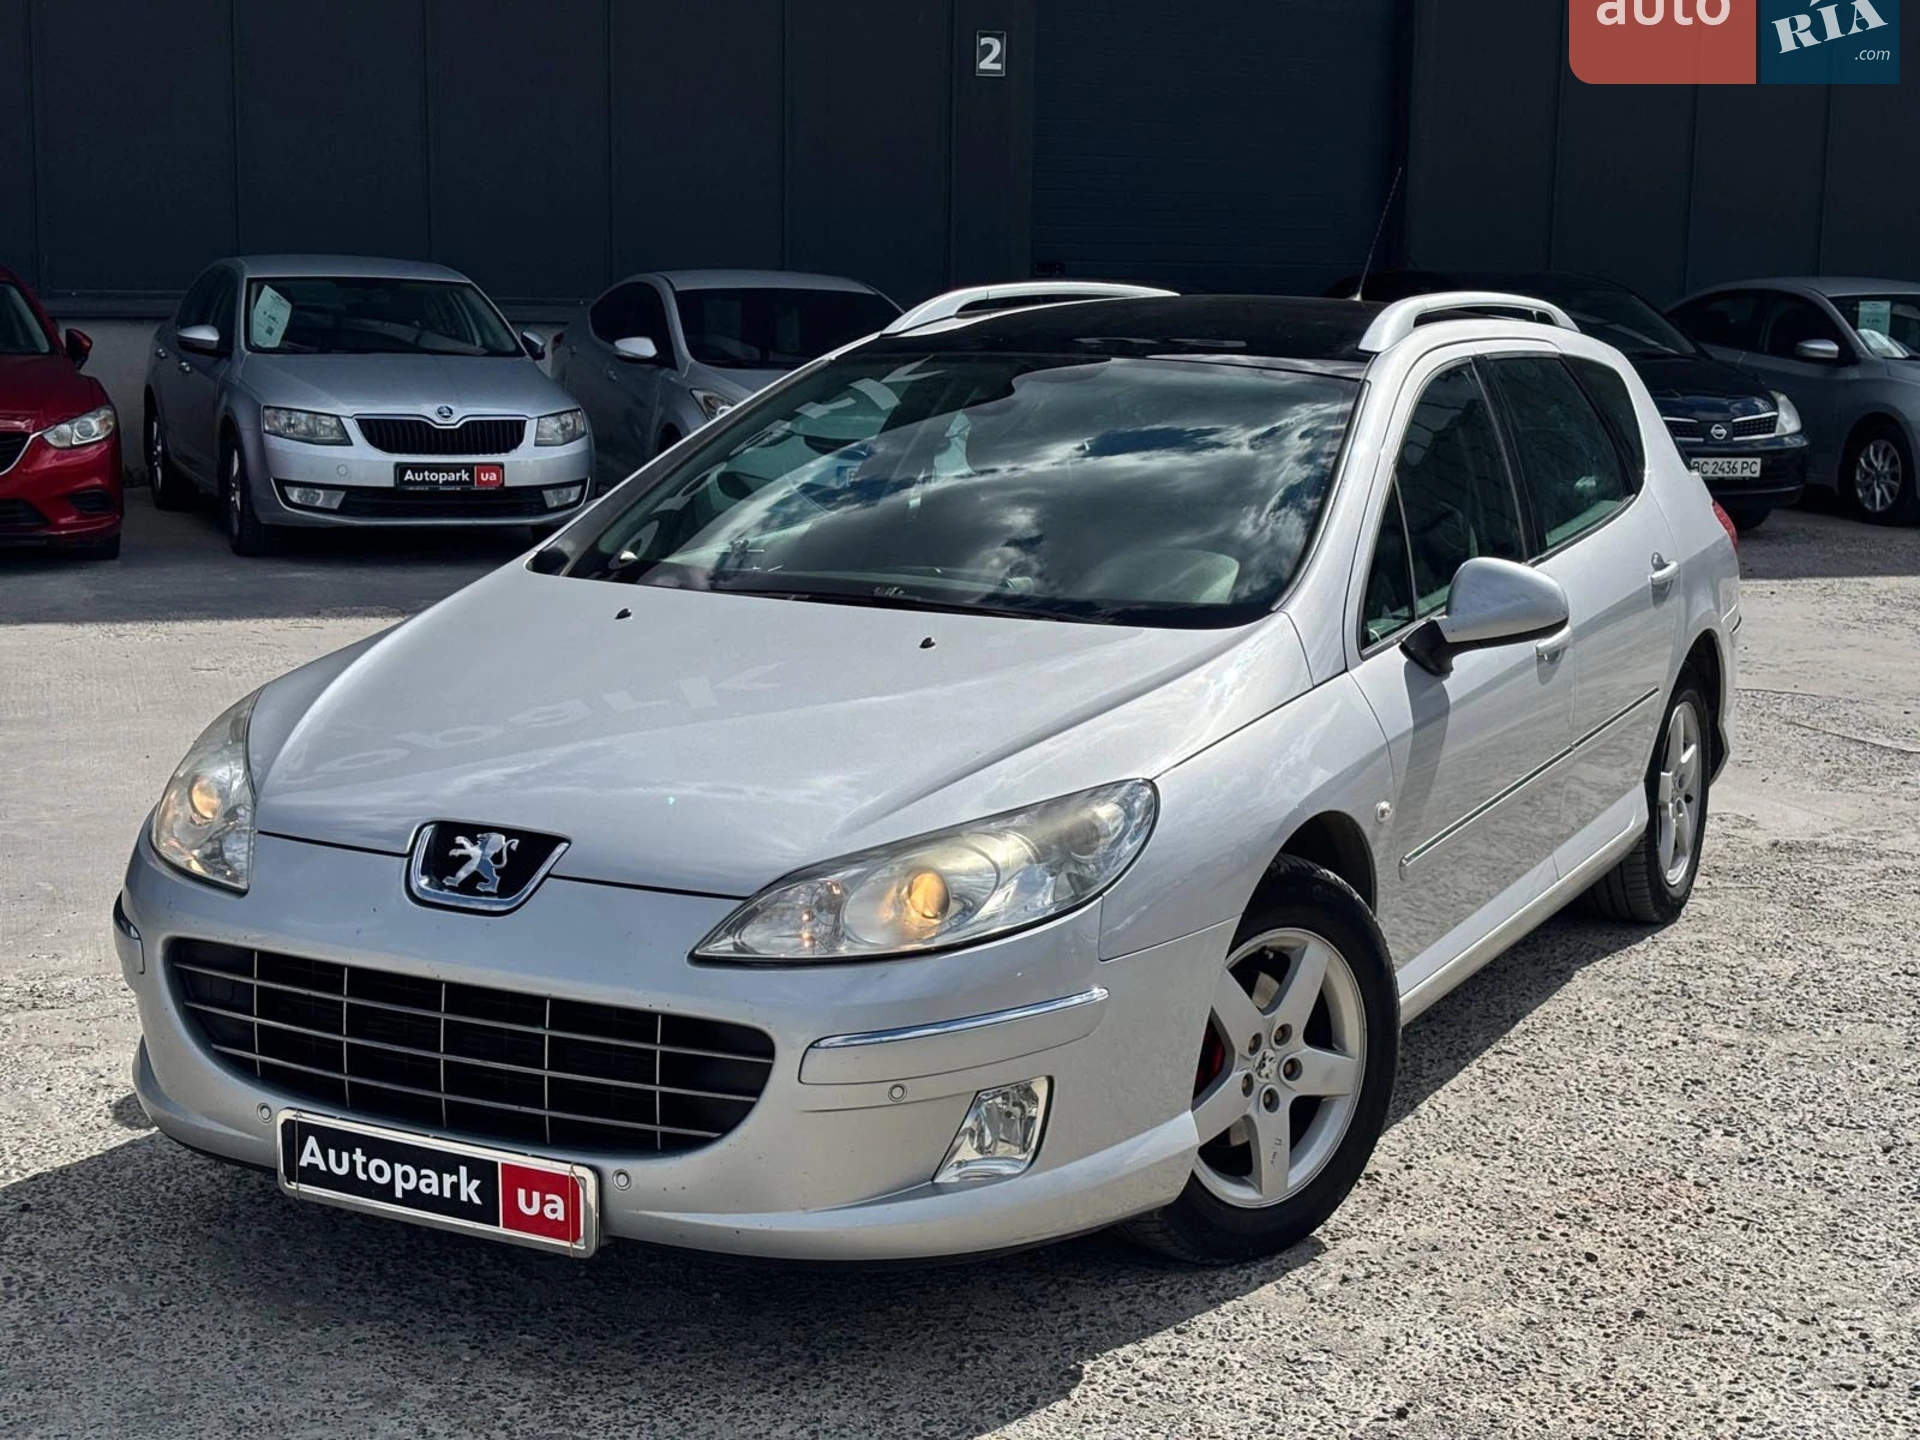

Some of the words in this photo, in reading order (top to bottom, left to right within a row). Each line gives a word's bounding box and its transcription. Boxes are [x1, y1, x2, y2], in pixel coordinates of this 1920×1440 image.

[979, 37, 1002, 70] 2
[403, 469, 470, 484] Autopark
[481, 472, 497, 481] ua
[1711, 461, 1738, 475] 2436
[1741, 461, 1758, 475] PC
[299, 1135, 483, 1205] Autopark
[517, 1187, 565, 1222] ua
